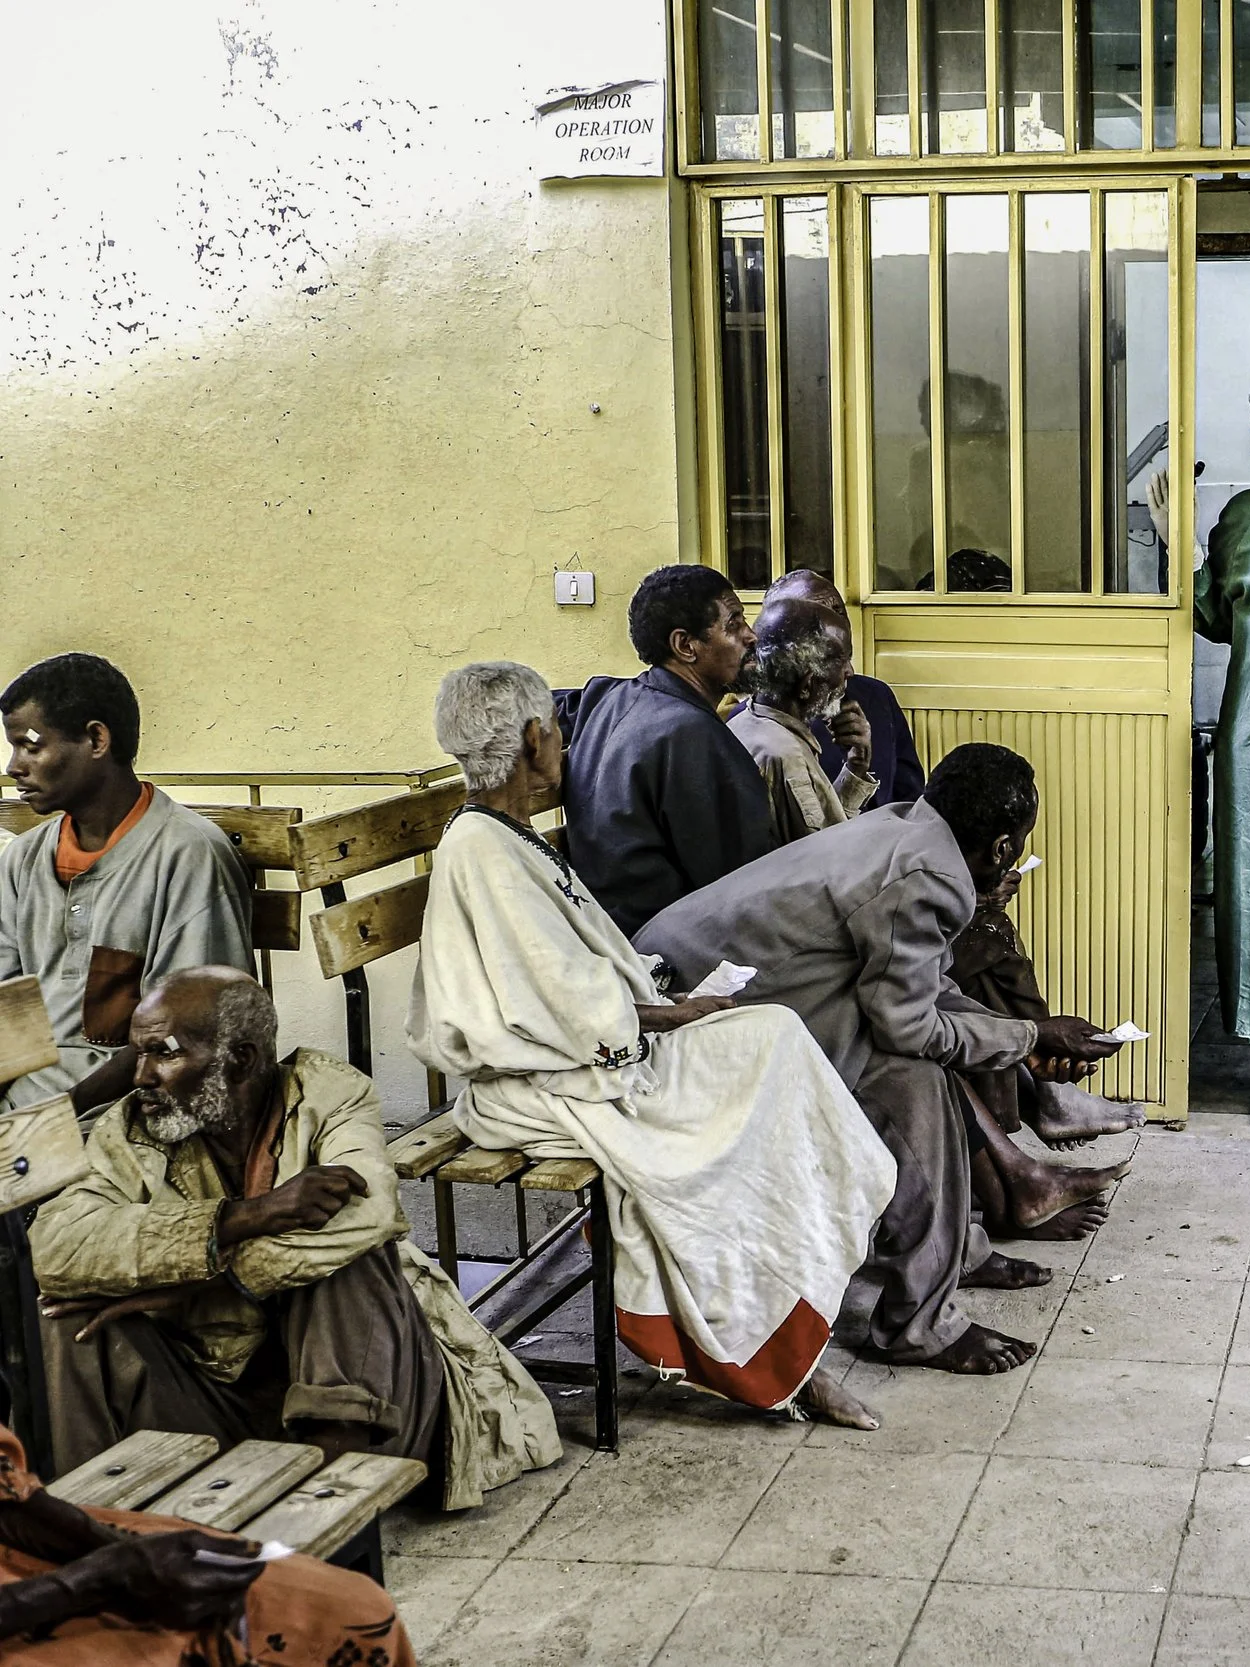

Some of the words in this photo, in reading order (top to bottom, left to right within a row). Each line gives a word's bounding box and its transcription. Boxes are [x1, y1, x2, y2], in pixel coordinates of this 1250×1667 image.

[574, 93, 632, 111] MAJOR
[555, 118, 655, 139] OPERATION
[579, 145, 631, 162] ROOM
